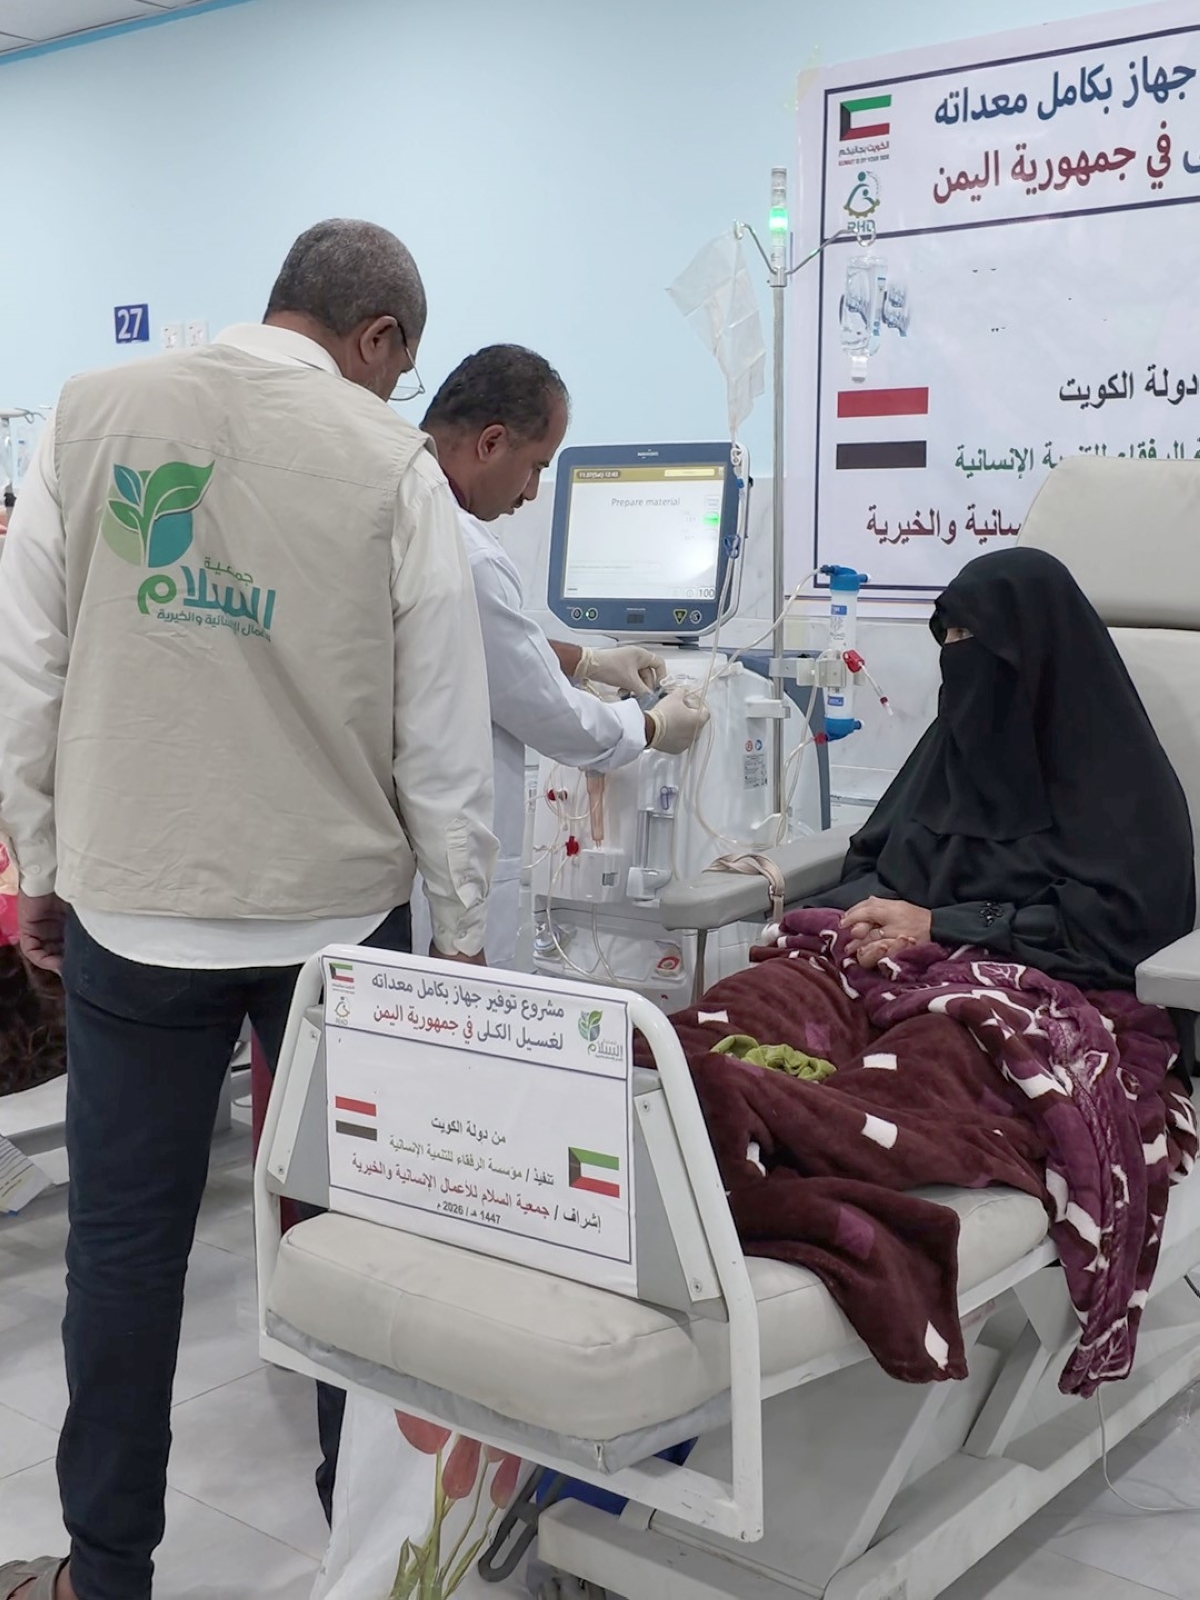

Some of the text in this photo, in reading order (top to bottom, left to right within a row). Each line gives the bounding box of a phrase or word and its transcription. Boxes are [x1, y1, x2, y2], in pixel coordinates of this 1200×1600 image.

[934, 56, 1197, 125] جهاز بكامل معداته
[933, 150, 999, 203] اليمن
[1010, 143, 1136, 195] جمهورية
[1146, 120, 1171, 190] في
[117, 308, 143, 340] 27
[1059, 363, 1200, 410] دولة الكويت
[955, 444, 1034, 479] الإنسانية
[611, 497, 681, 507] Prepare material
[866, 504, 957, 545] والخيرية
[204, 556, 254, 587] جمعية
[699, 588, 715, 598] 100
[137, 565, 276, 630] السلام
[157, 608, 202, 626] والخيرية
[371, 973, 565, 1021] مشروع توفير جهاز بكامل معداته
[373, 1004, 563, 1051] لغسيل الكلى في جمهورية اليمن
[431, 1118, 506, 1145] من دولة الكويت
[389, 1135, 554, 1186] تنفيذ / مؤسسة الرفقاء للتنمية الإنسانية
[352, 1153, 601, 1234] إشراف / جمعية السلام للأعمال الإنسانية والخيرية
[443, 1201, 464, 1215] 2026
[480, 1210, 501, 1225] 1447
